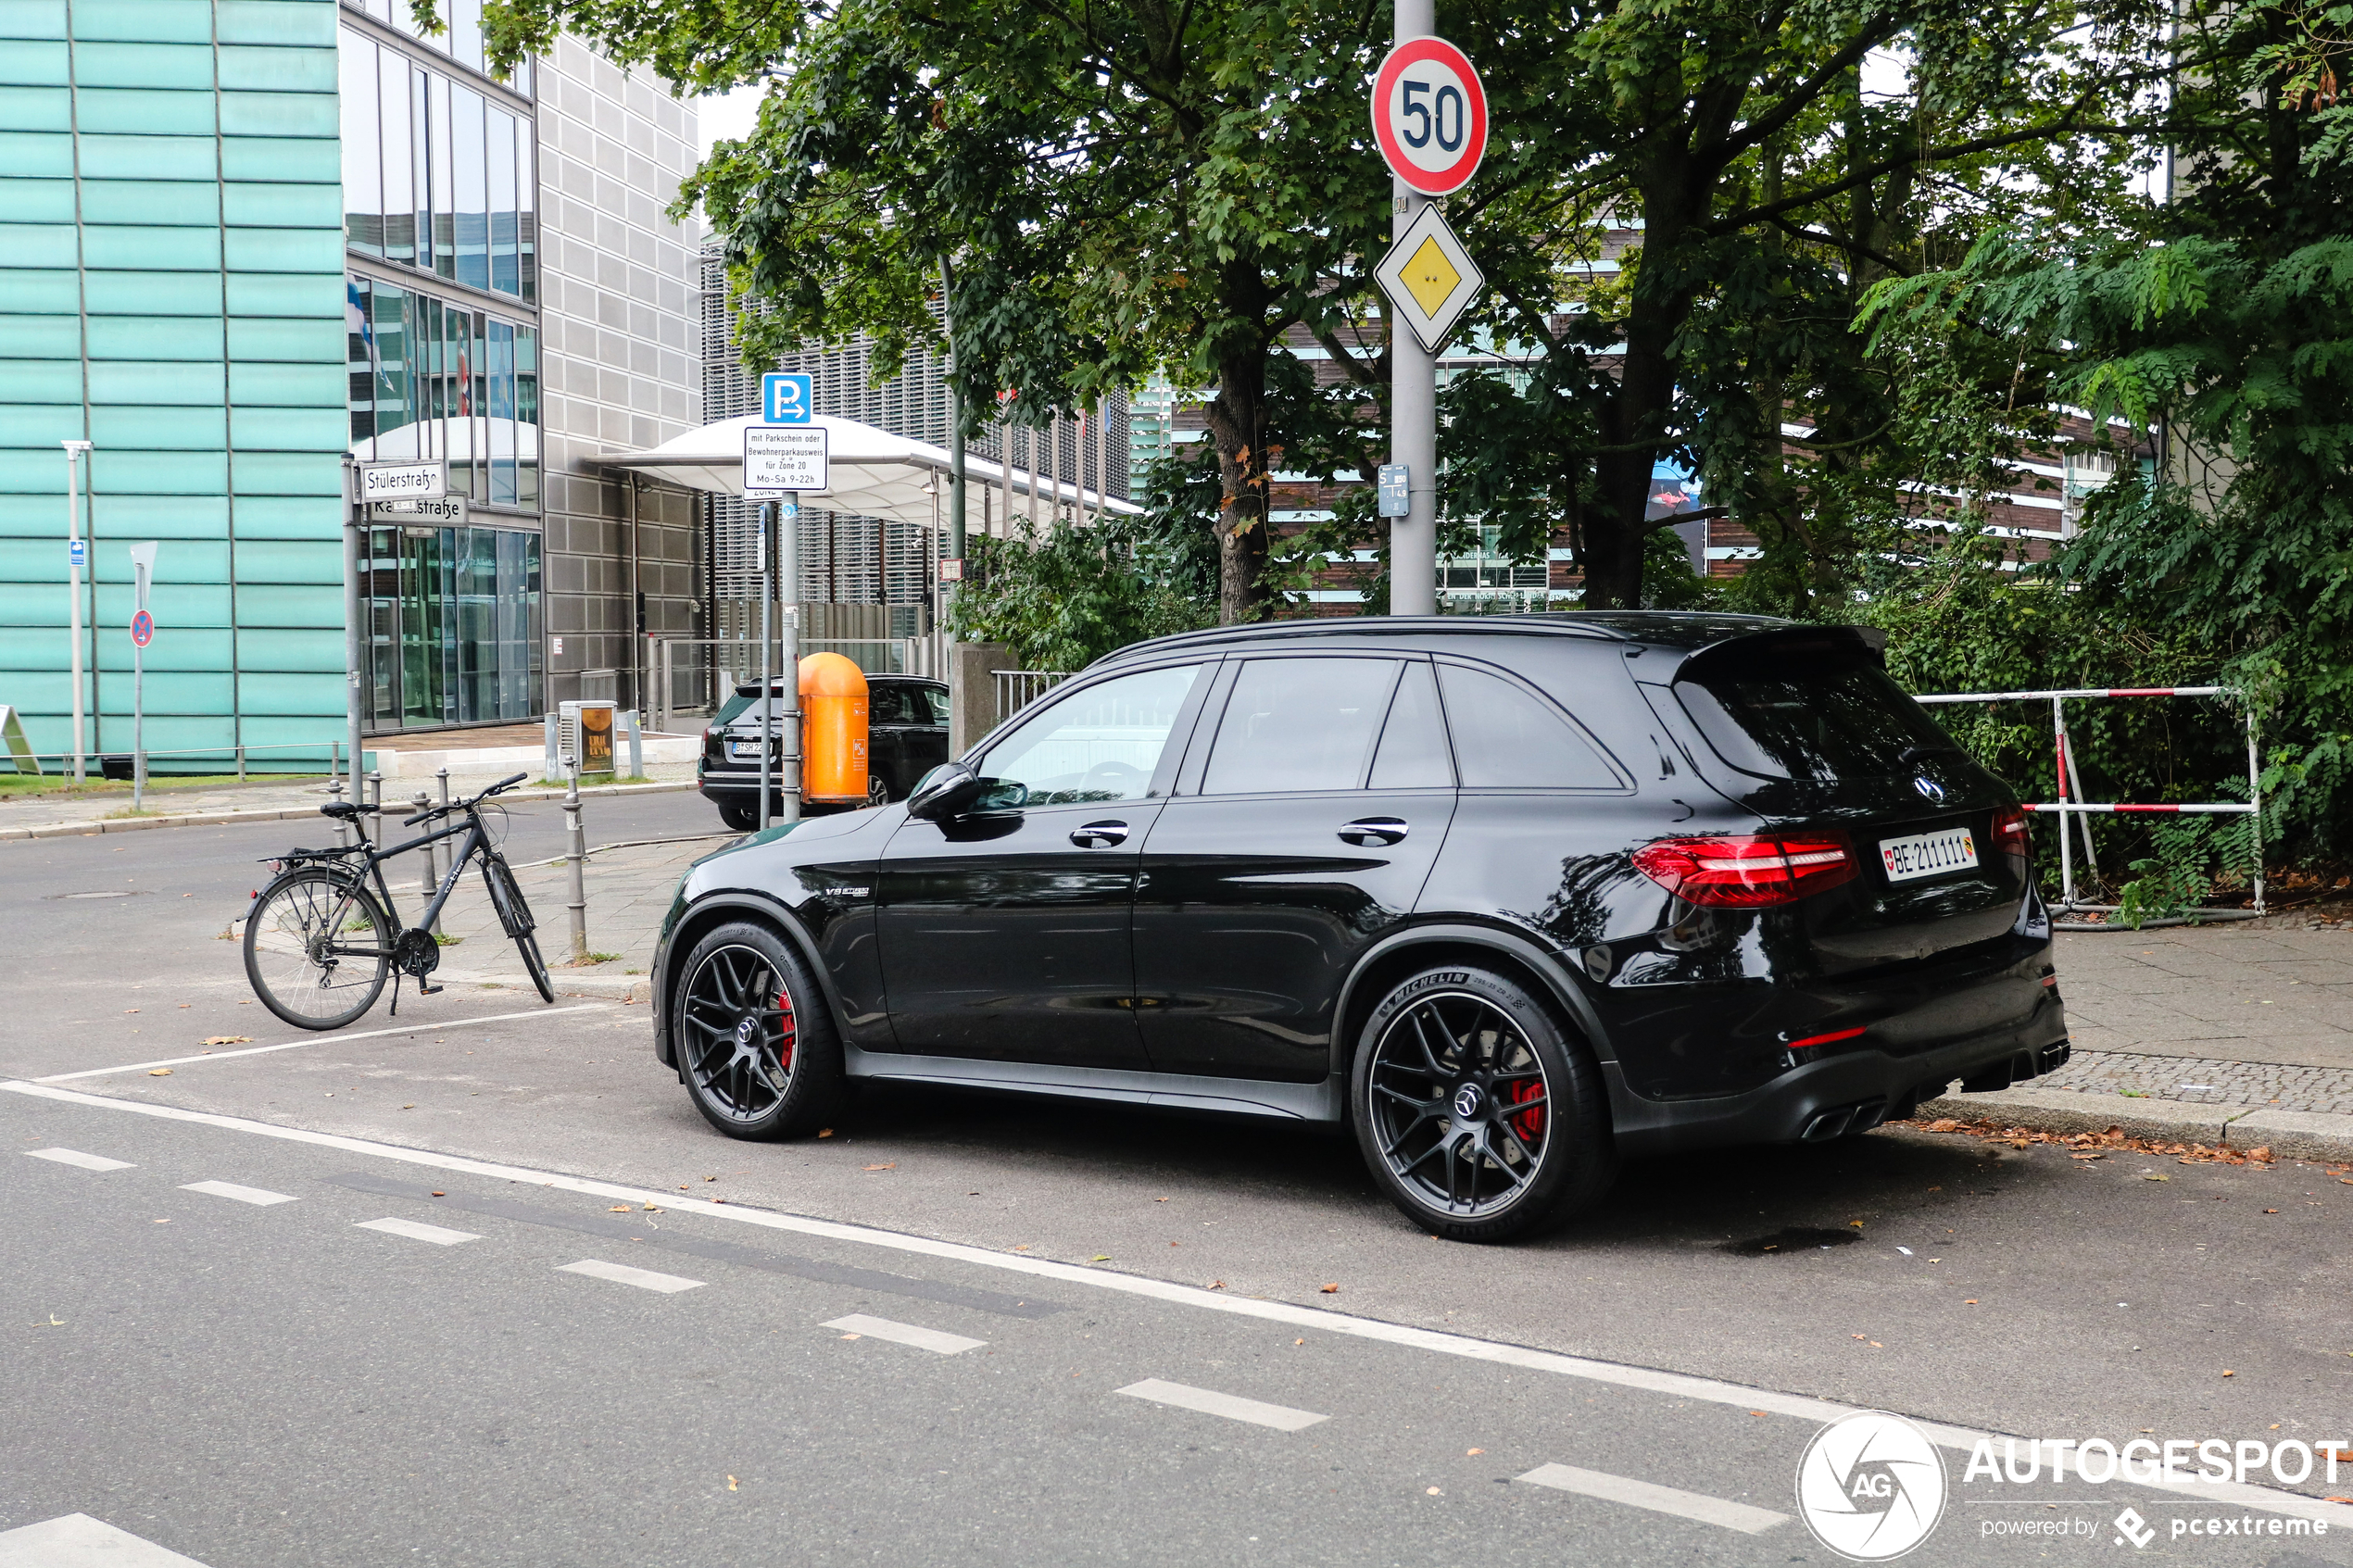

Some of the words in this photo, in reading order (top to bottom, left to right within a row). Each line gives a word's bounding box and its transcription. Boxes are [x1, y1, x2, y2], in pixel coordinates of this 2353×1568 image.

[1403, 80, 1463, 152] 50
[774, 380, 800, 419] P
[751, 433, 763, 443] mit
[765, 433, 802, 443] Parkschein
[804, 434, 821, 443] oder
[748, 447, 824, 458] Bewohnerparkausweis
[765, 461, 775, 470] für
[779, 461, 795, 470] Zone
[798, 461, 807, 470] 20
[757, 474, 786, 483] Mo-Sa
[789, 475, 815, 483] 9-22h
[1379, 472, 1388, 484] S
[374, 499, 459, 520] Rastraße
[444, 859, 465, 894] ortler
[1394, 972, 1466, 1002] MICHELIN
[1473, 977, 1497, 990] 295/35
[1496, 986, 1506, 997] ZR
[1505, 993, 1514, 1001] 21
